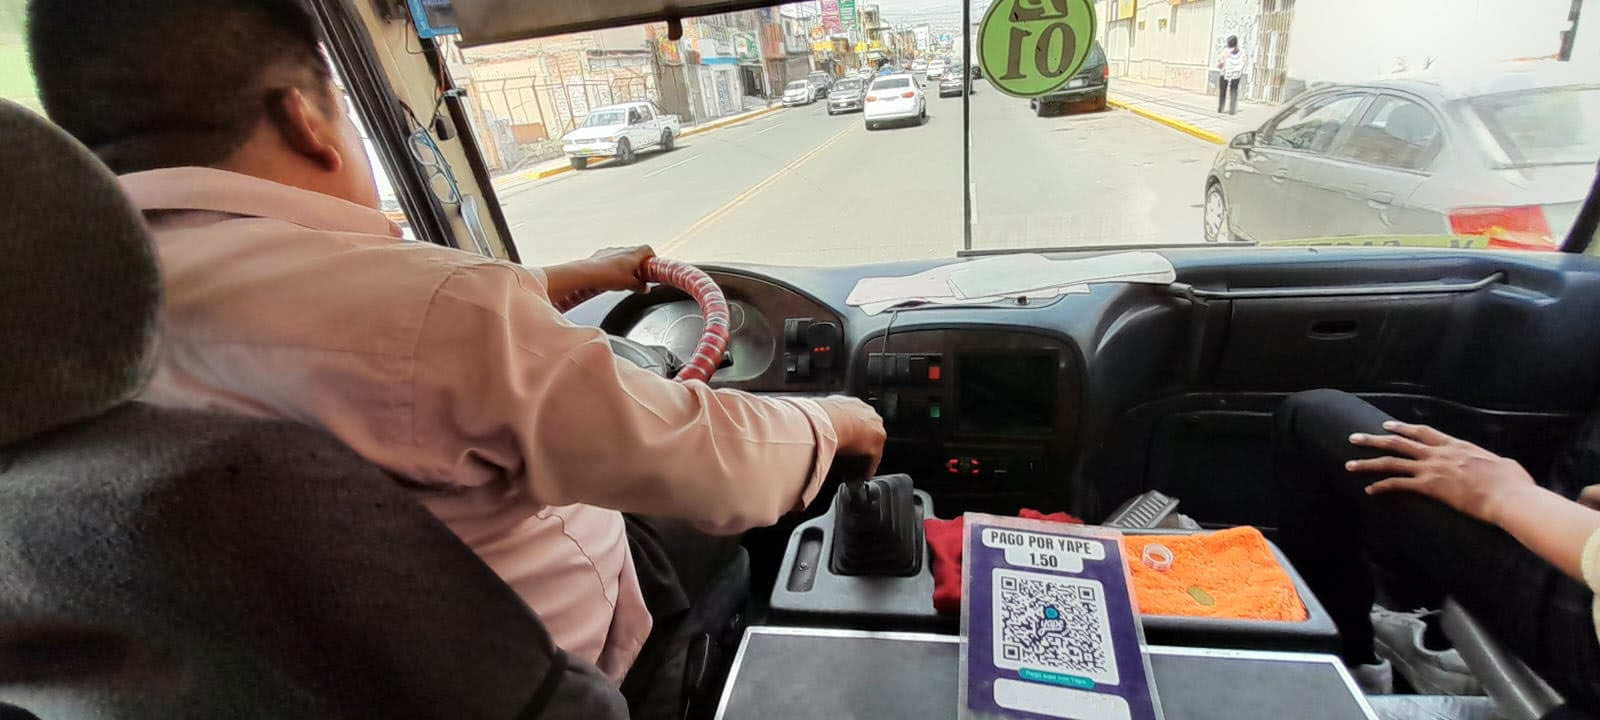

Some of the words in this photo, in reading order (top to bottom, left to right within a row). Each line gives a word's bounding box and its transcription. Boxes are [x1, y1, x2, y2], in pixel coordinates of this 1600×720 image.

[991, 531, 1024, 546] PAGO
[1029, 535, 1054, 550] POR
[1058, 538, 1092, 555] YAPE
[1029, 553, 1058, 568] 1.50
